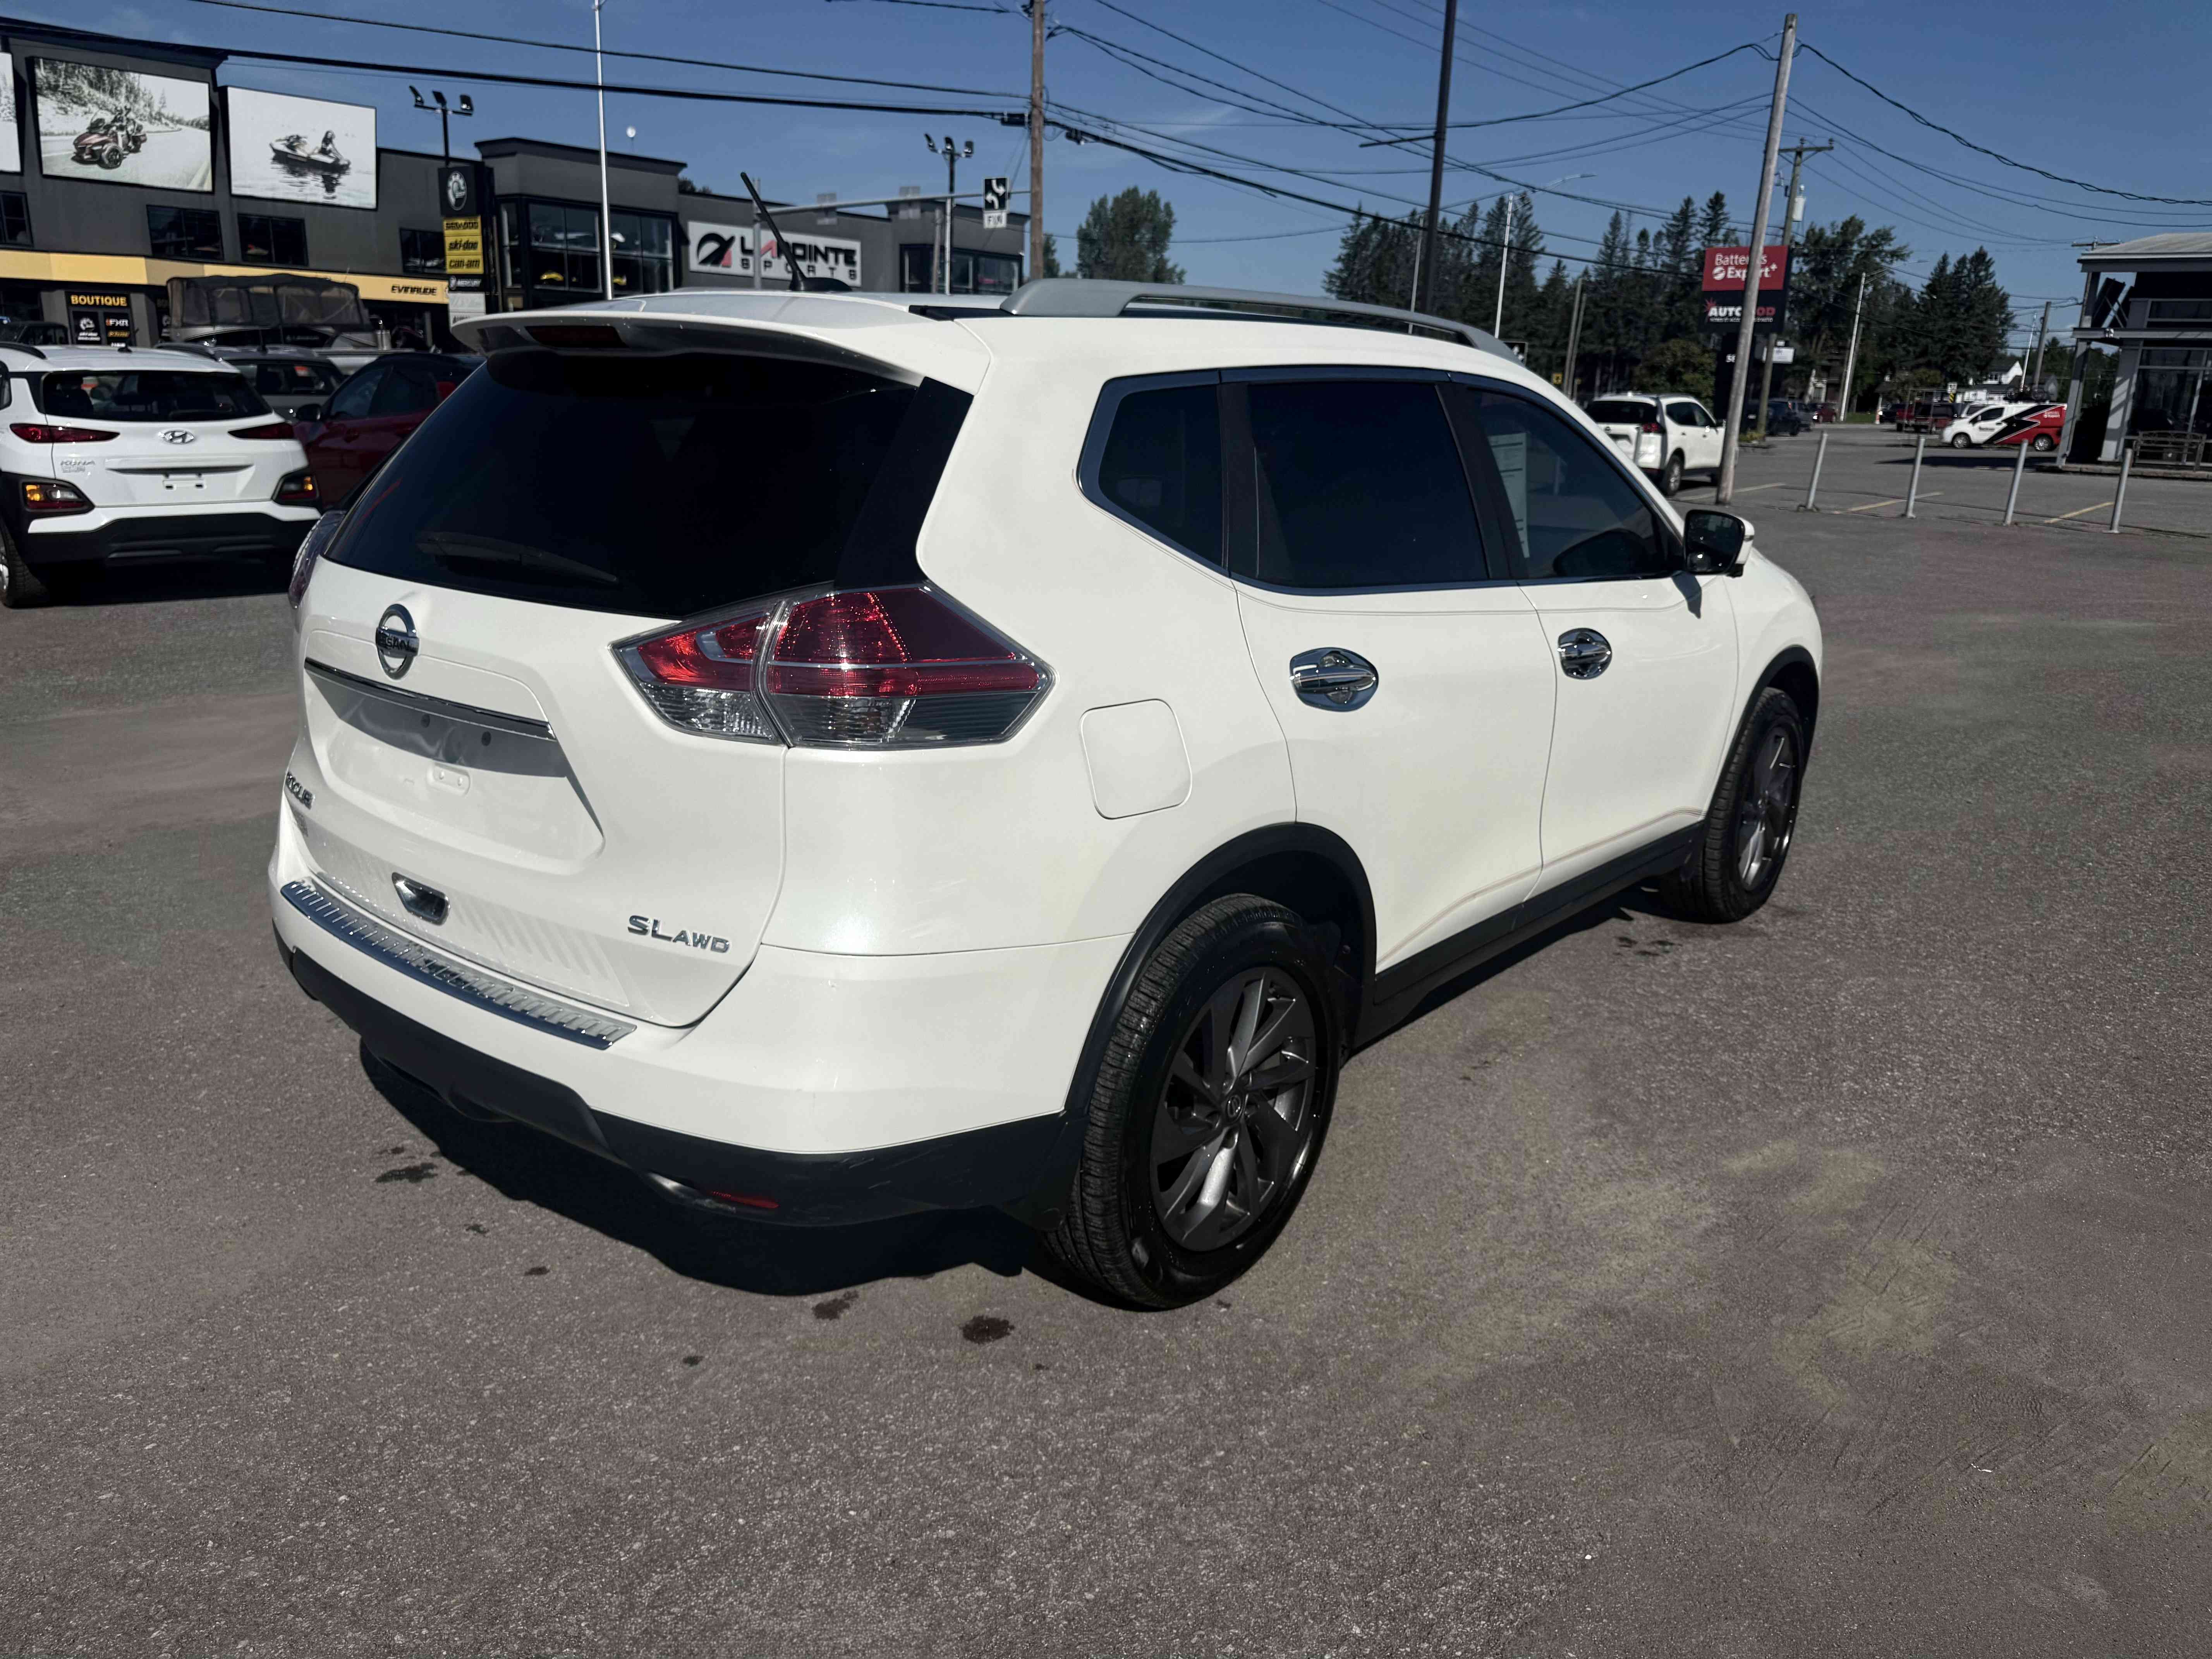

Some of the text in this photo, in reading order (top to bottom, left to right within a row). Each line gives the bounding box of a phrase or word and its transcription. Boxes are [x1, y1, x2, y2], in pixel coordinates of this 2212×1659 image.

[1715, 253, 1768, 266] Batters
[391, 285, 437, 295] EVINRUDE
[70, 295, 127, 306] BOUTIQUE
[627, 915, 730, 953] SL AWD
